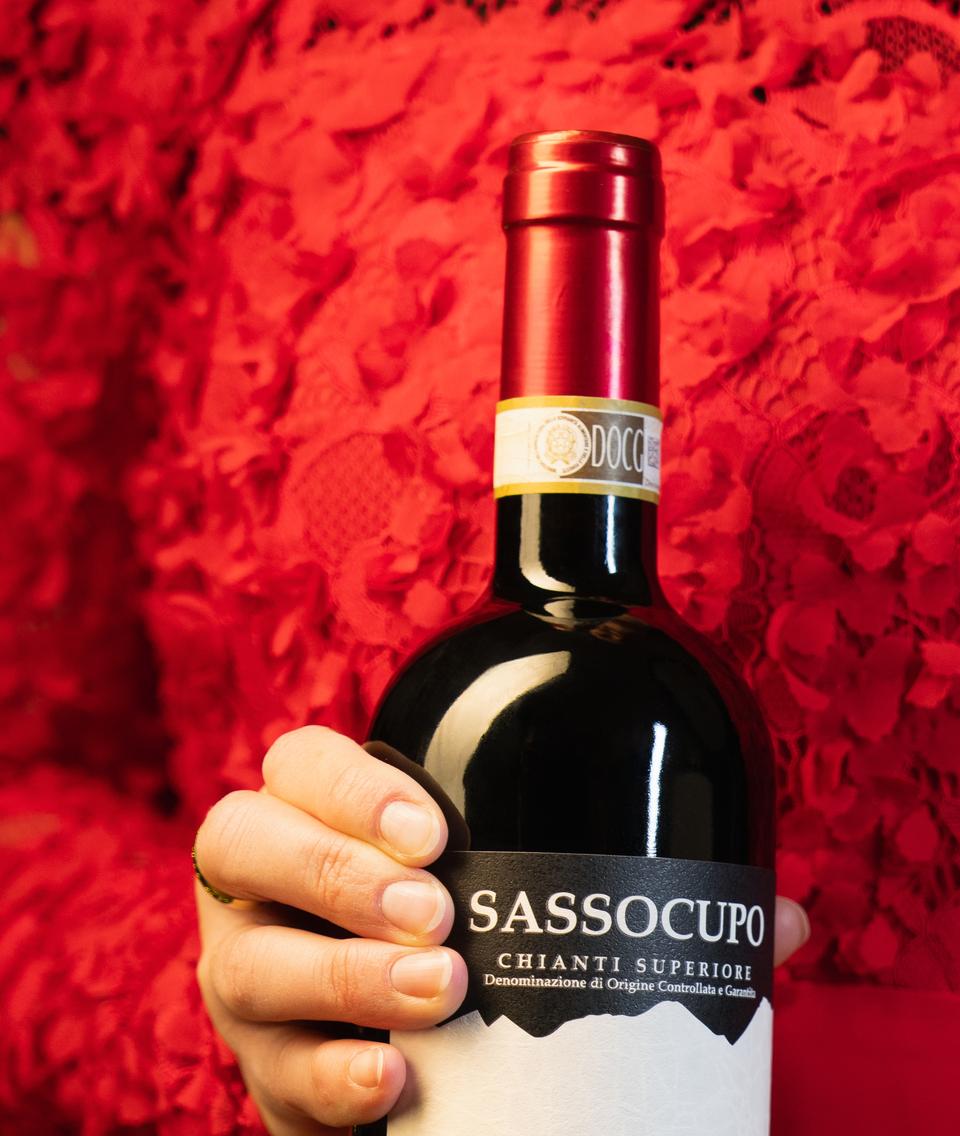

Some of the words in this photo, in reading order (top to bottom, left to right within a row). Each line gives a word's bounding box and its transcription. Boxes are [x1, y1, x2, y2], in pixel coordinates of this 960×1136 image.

[592, 424, 644, 473] DOCG
[469, 890, 765, 947] SASSOCUPO
[485, 974, 586, 988] Denominazione
[591, 977, 603, 989] di
[607, 978, 655, 994] Origine
[658, 981, 716, 995] Controllata
[718, 987, 724, 996] e
[498, 953, 620, 971] CHIANTI
[636, 958, 752, 980] SUPERIORE
